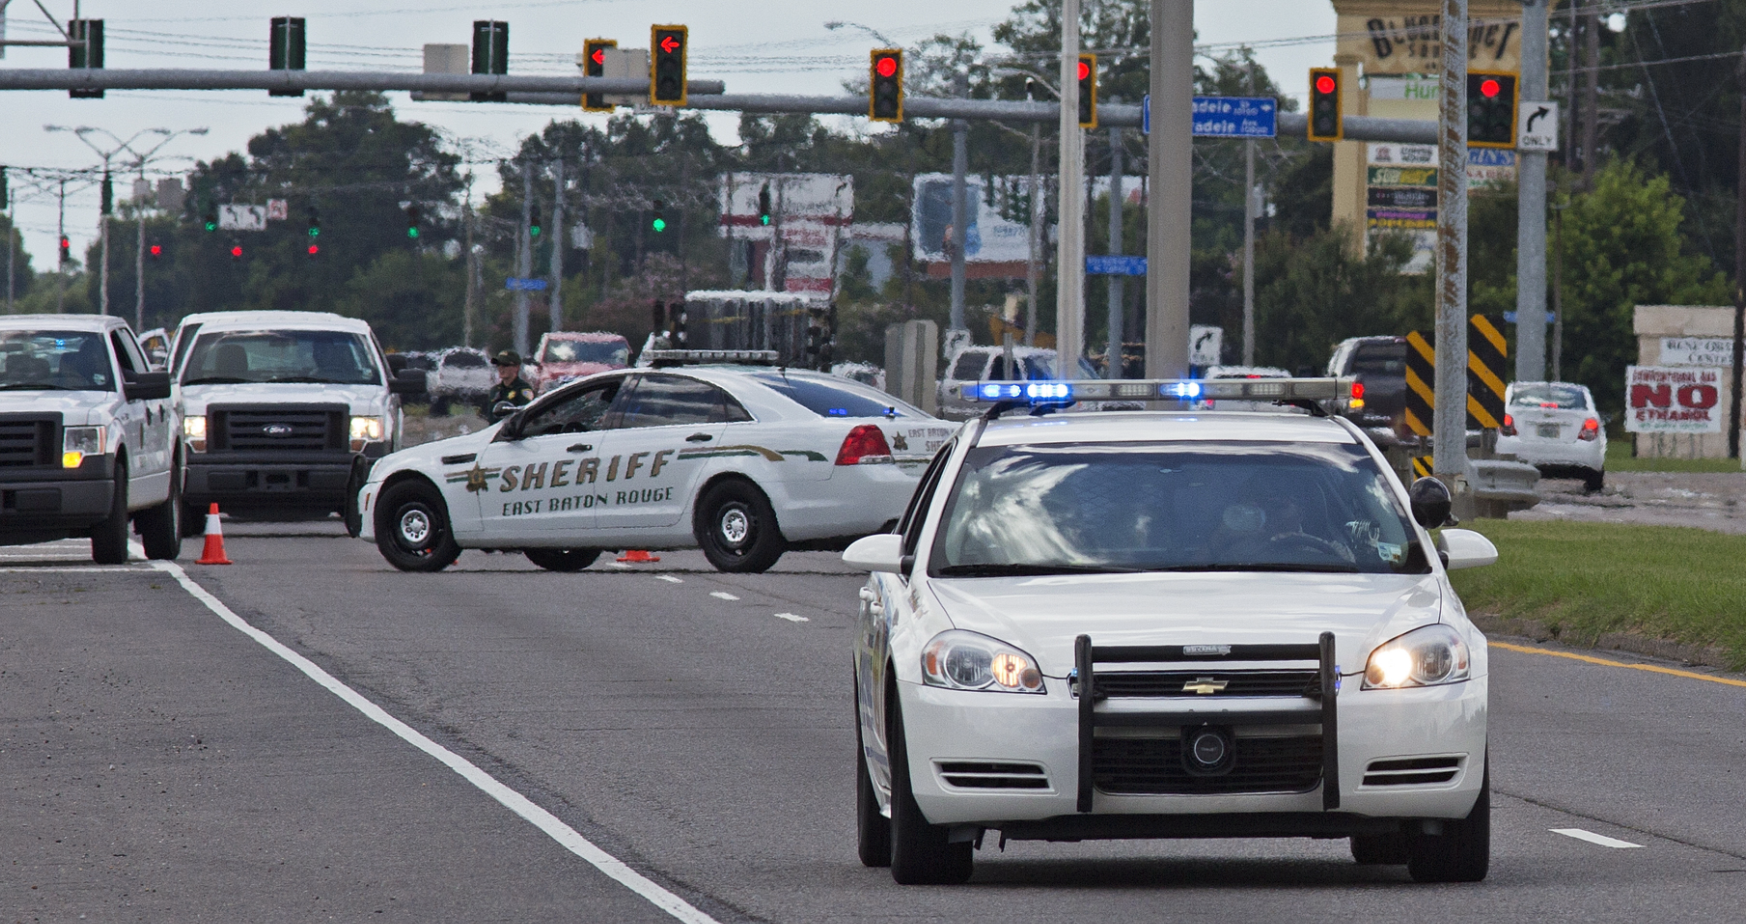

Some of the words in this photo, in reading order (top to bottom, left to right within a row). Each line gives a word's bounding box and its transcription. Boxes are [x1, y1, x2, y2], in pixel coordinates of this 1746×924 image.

[1192, 101, 1231, 114] adele
[1193, 120, 1236, 133] adele
[1522, 135, 1552, 146] ONLY
[1372, 167, 1436, 184] SUBWAY
[1631, 384, 1718, 409] NO
[1636, 410, 1711, 421] ETHANOL
[908, 428, 925, 437] EAST
[500, 449, 675, 492] SHERIFF
[502, 500, 542, 516] EAST
[549, 493, 608, 511] BATON
[616, 487, 674, 505] ROUGE
